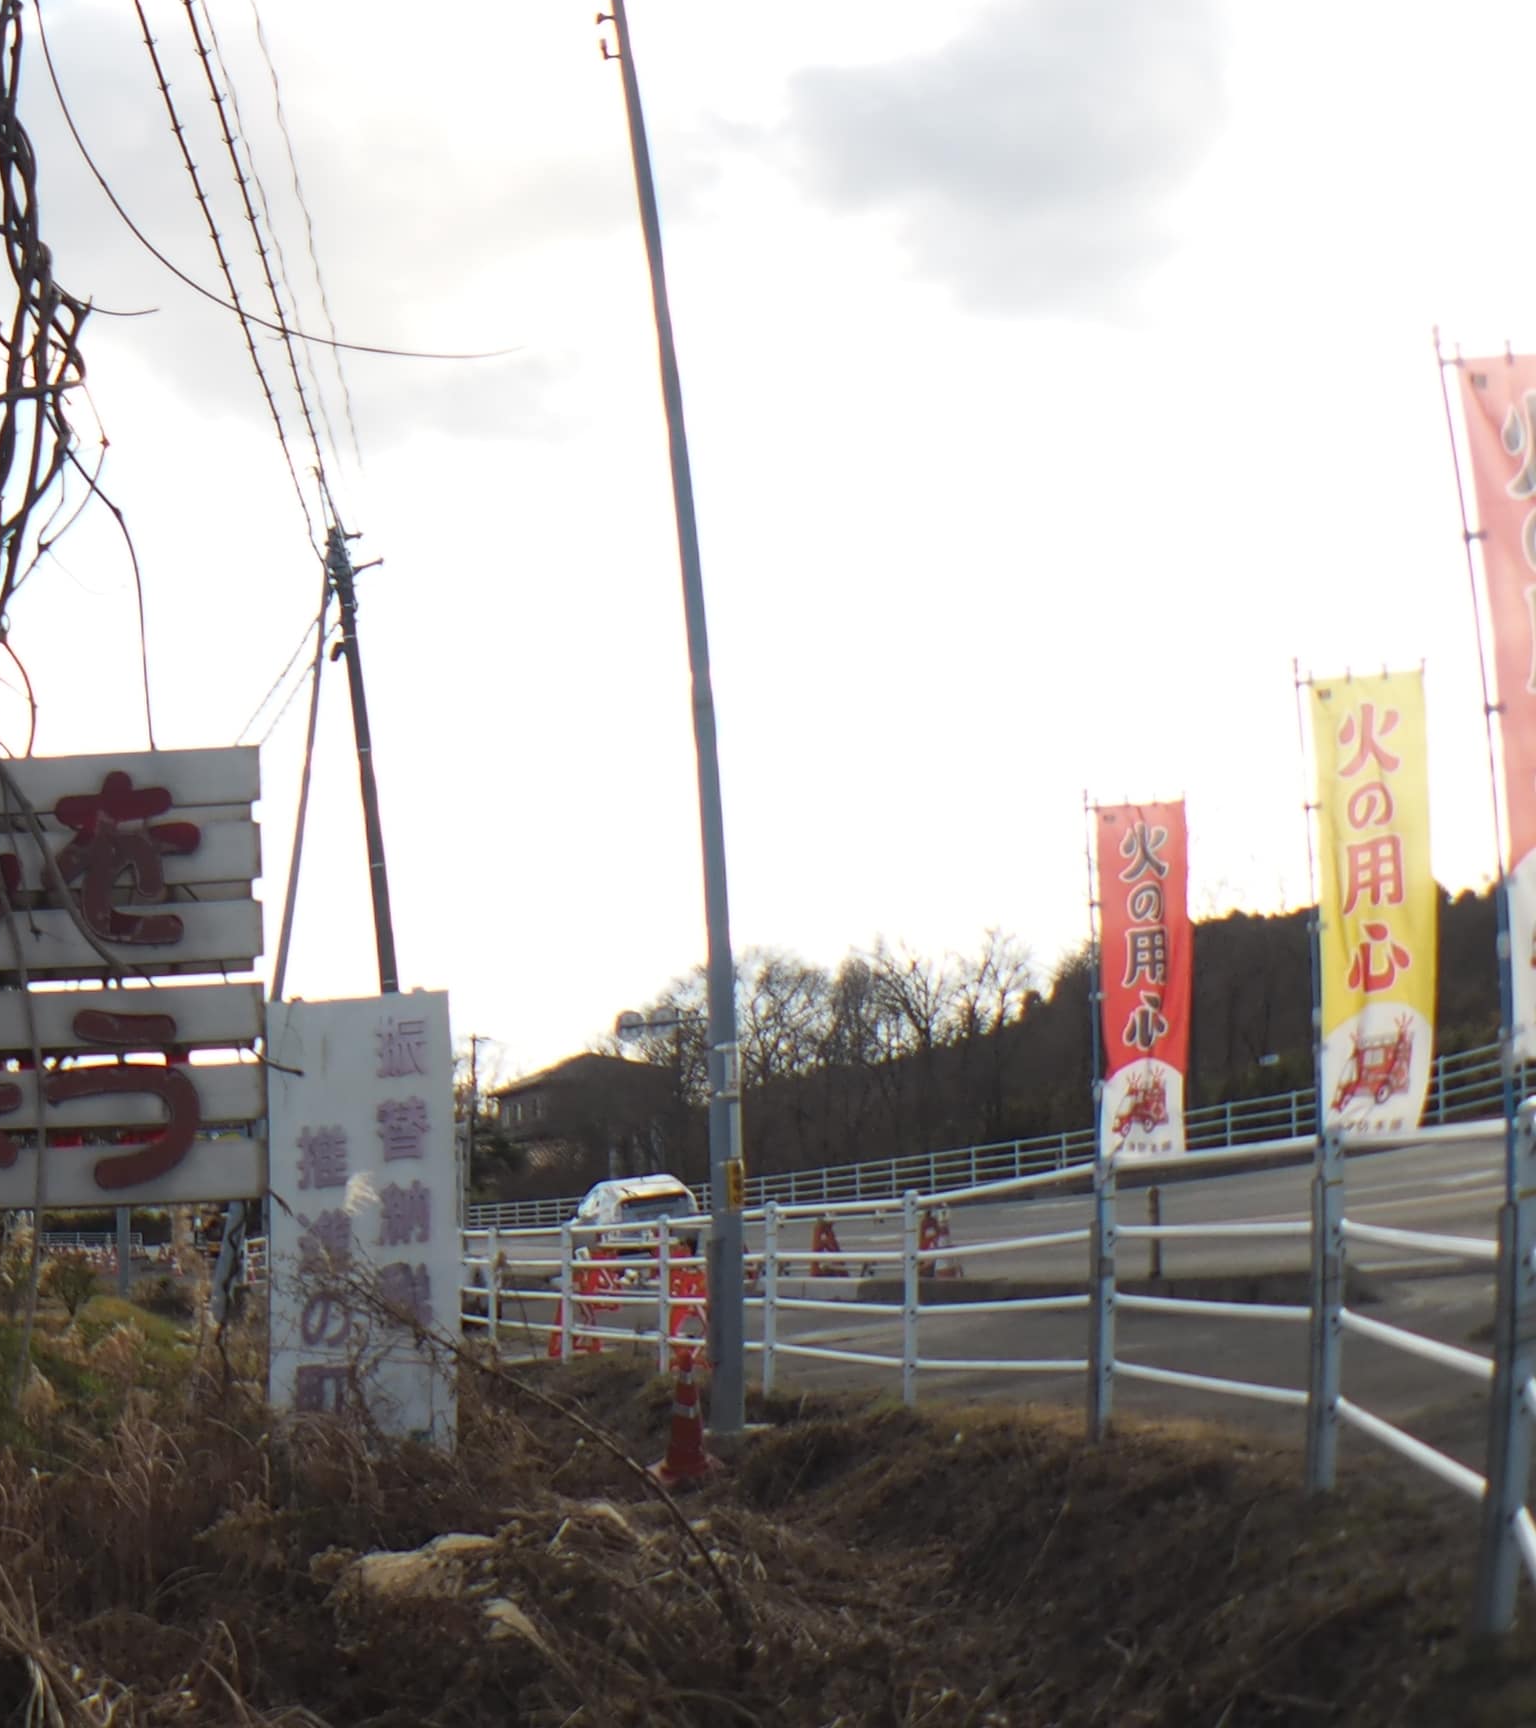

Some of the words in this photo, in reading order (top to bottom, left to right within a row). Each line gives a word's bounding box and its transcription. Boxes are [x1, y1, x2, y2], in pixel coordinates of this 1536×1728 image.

[1119, 821, 1169, 1051] 火の用心
[1337, 702, 1411, 993] 火の用心
